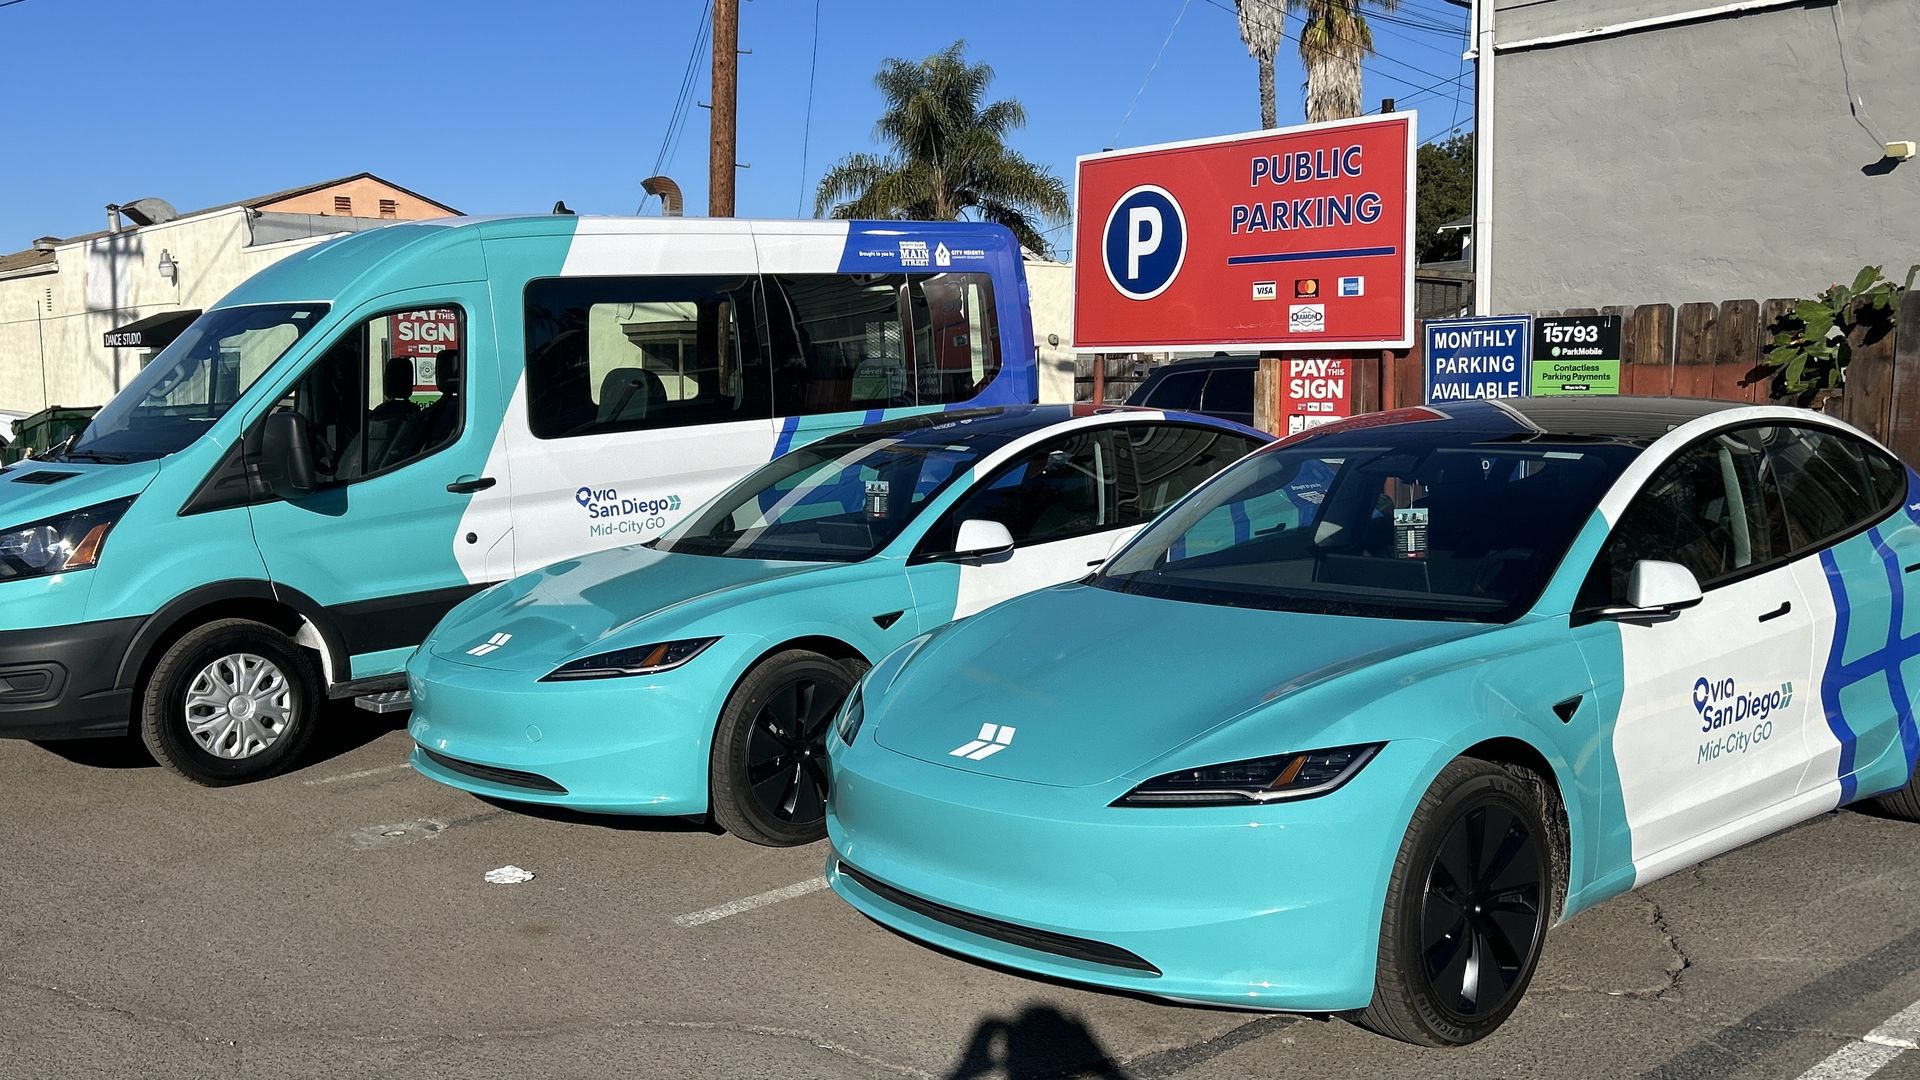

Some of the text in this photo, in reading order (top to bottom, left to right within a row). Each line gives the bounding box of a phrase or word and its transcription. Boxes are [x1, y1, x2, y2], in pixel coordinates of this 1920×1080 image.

[1250, 144, 1363, 188] PUBLIC
[1231, 192, 1382, 235] PARKING
[1127, 206, 1163, 280] P
[900, 249, 929, 259] MAIN
[1256, 287, 1273, 295] VISA
[105, 332, 142, 346] DANCE STUDIO
[398, 321, 455, 341] SIGN
[1434, 329, 1517, 349] MONTHLY
[1543, 325, 1598, 343] 15793
[1562, 347, 1603, 355] ParkMobile
[1290, 358, 1331, 377] PAY
[1436, 355, 1515, 374] PARKING
[1553, 364, 1600, 372] Contactless
[1542, 373, 1611, 382] Parking Payments
[1289, 379, 1344, 399] SIGN
[1432, 381, 1519, 400] AVAILABLE
[593, 489, 617, 502] via
[588, 498, 668, 518] San Diego
[590, 517, 665, 537] Mid-City GO
[1711, 678, 1734, 702] via
[1702, 691, 1780, 733] San Diego
[1697, 721, 1772, 765] Mid-City GO
